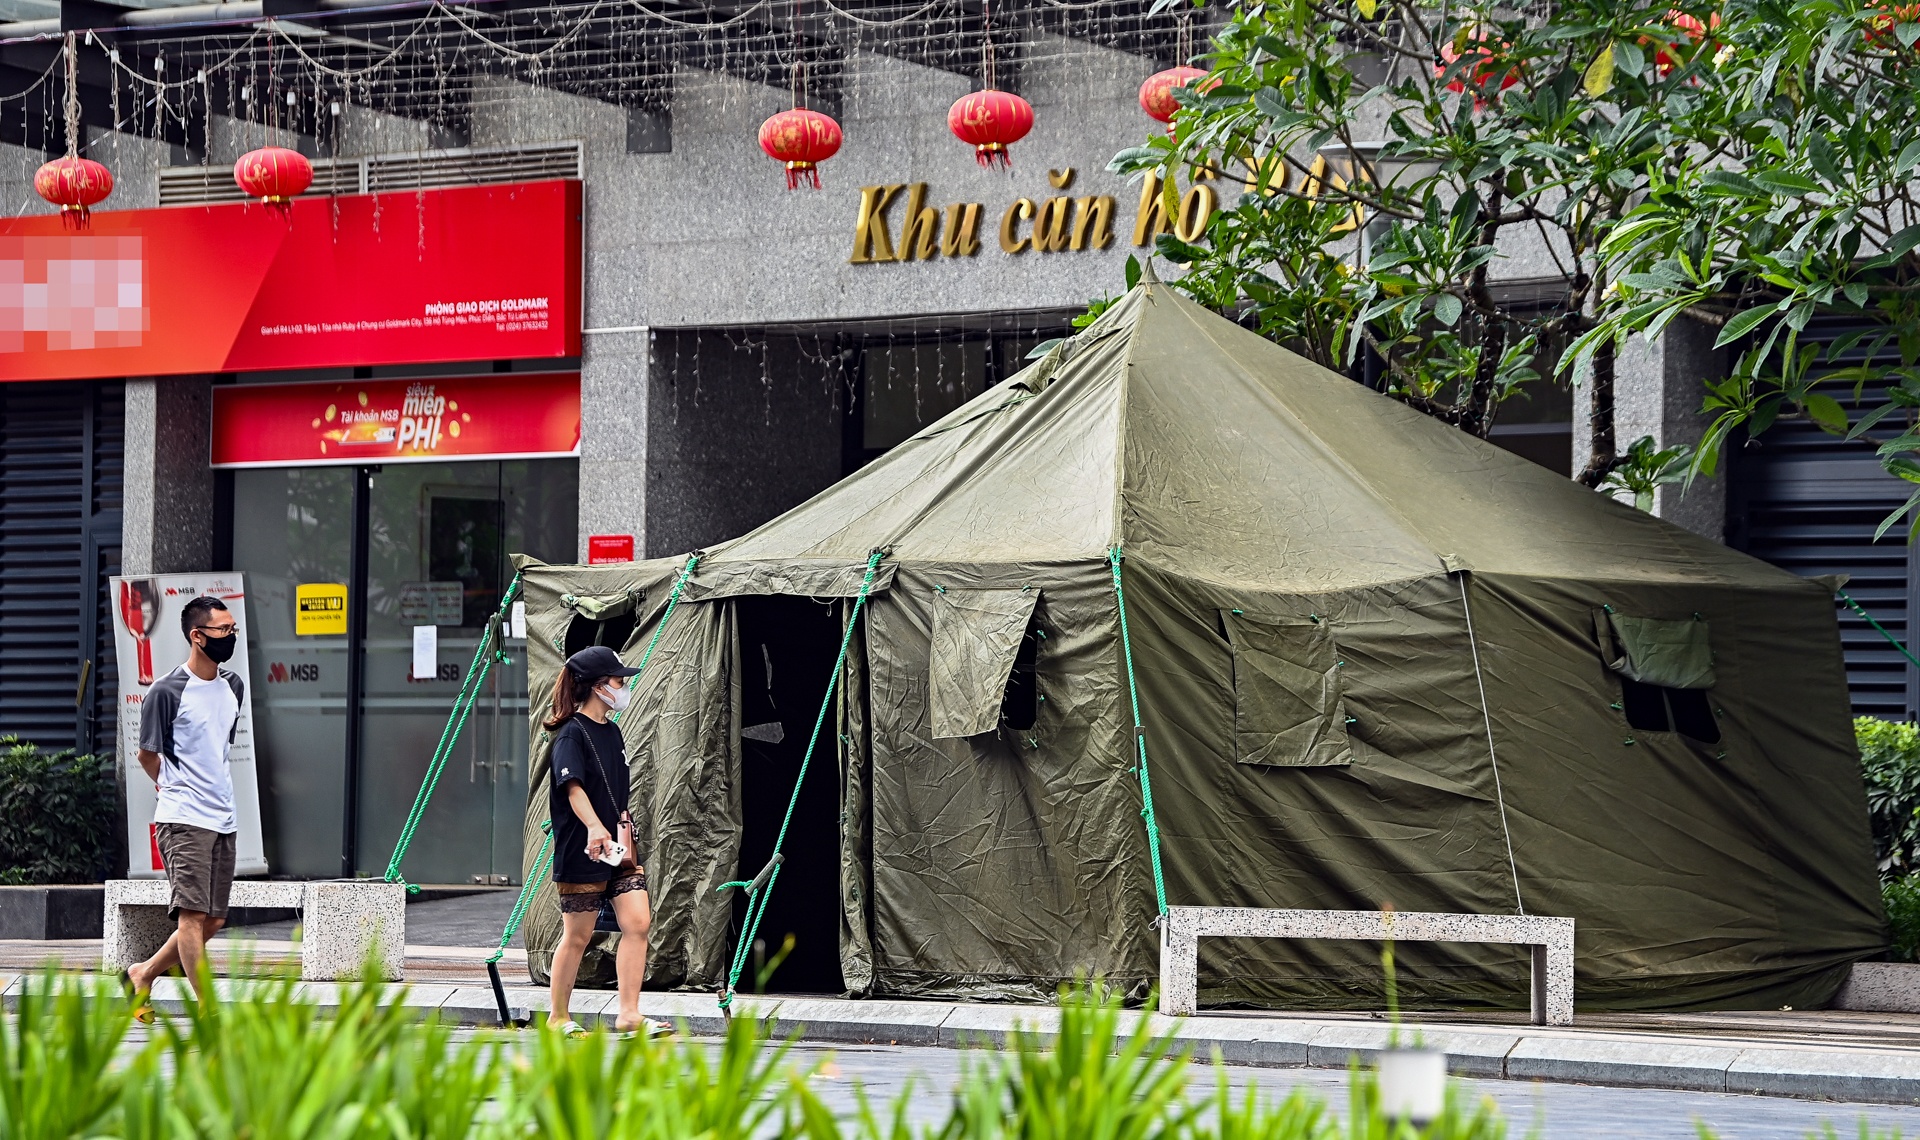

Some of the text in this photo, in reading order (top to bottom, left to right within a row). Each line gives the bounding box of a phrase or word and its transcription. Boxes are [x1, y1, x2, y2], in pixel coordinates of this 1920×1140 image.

[849, 181, 982, 264] Khu
[999, 167, 1116, 254] căn
[426, 297, 548, 316] PHÒNG GIAO DỊCH GOLDMARK
[386, 318, 410, 329] Goldmark
[341, 408, 399, 424] Tài khoản MSB
[178, 586, 196, 596] MSB
[290, 664, 319, 681] MSB
